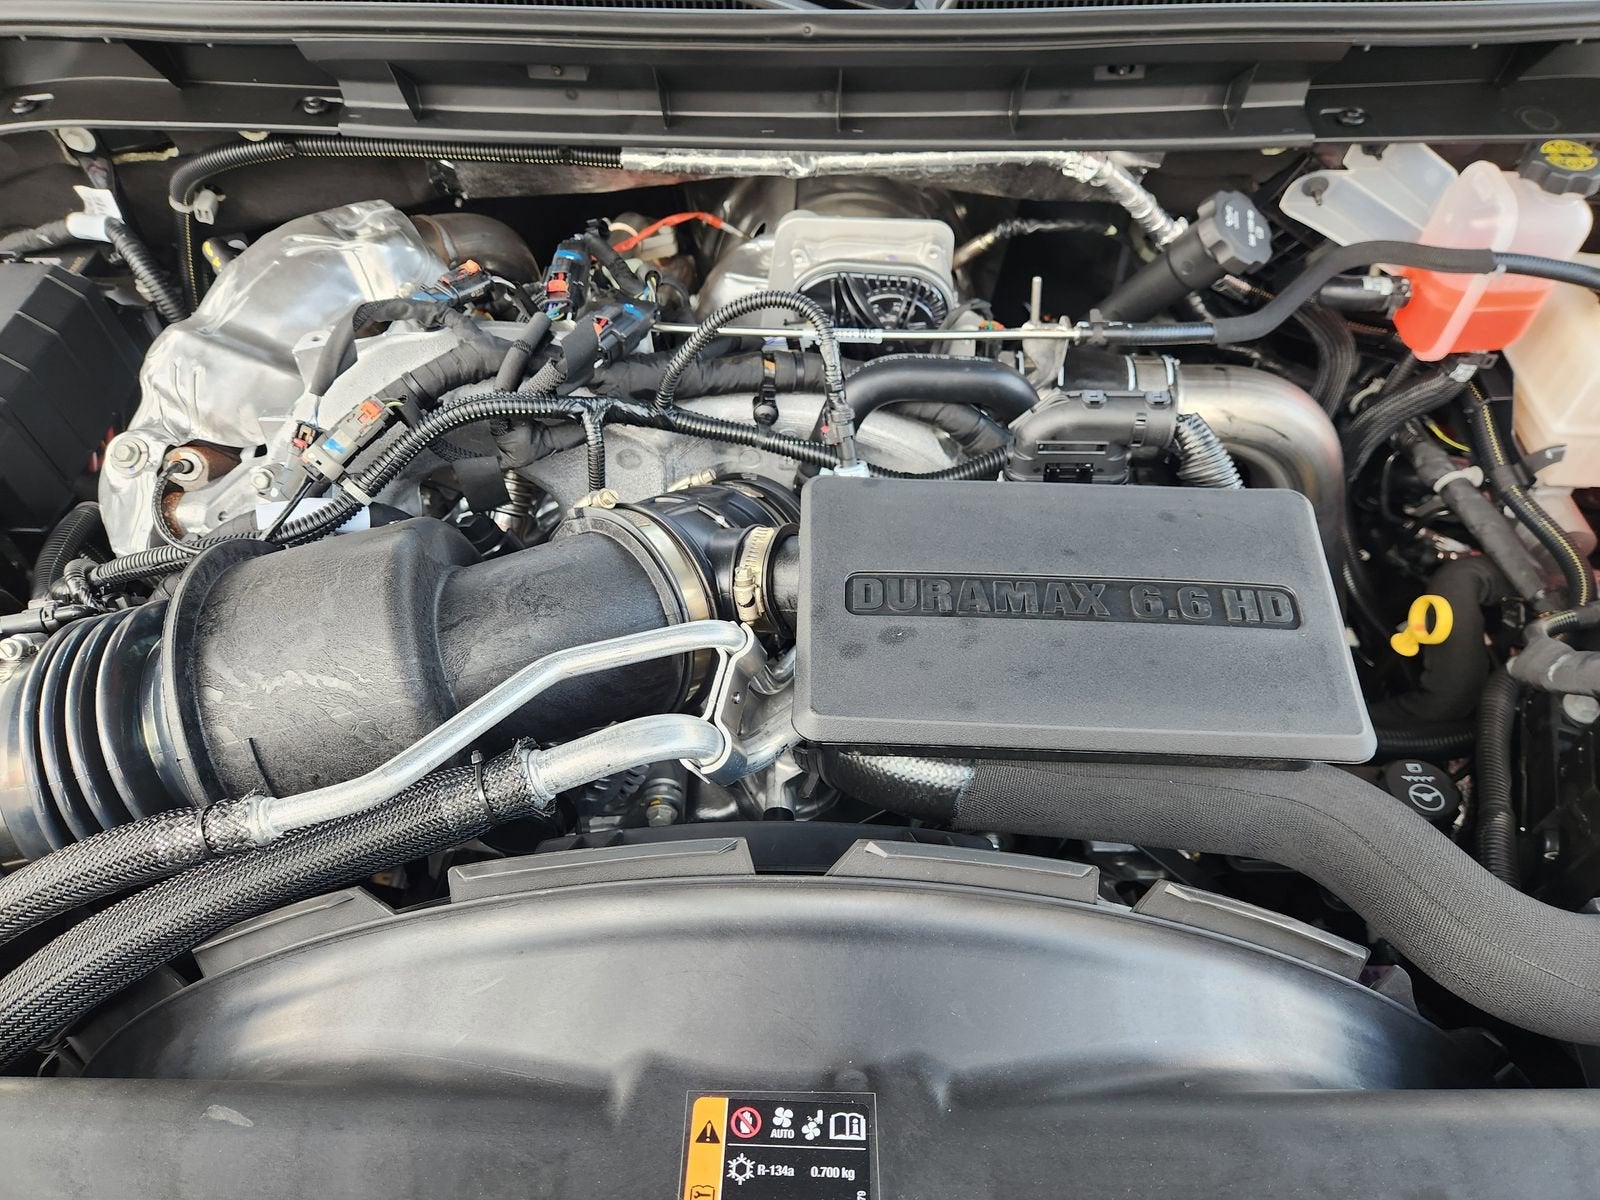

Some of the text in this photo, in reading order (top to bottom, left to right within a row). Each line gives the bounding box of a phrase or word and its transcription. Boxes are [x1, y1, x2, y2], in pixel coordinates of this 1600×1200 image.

[853, 578, 1295, 624] DURAMAX 6.6 HD
[770, 1128, 795, 1139] AUTO
[757, 1165, 856, 1181] R-134a 0.700 kg
